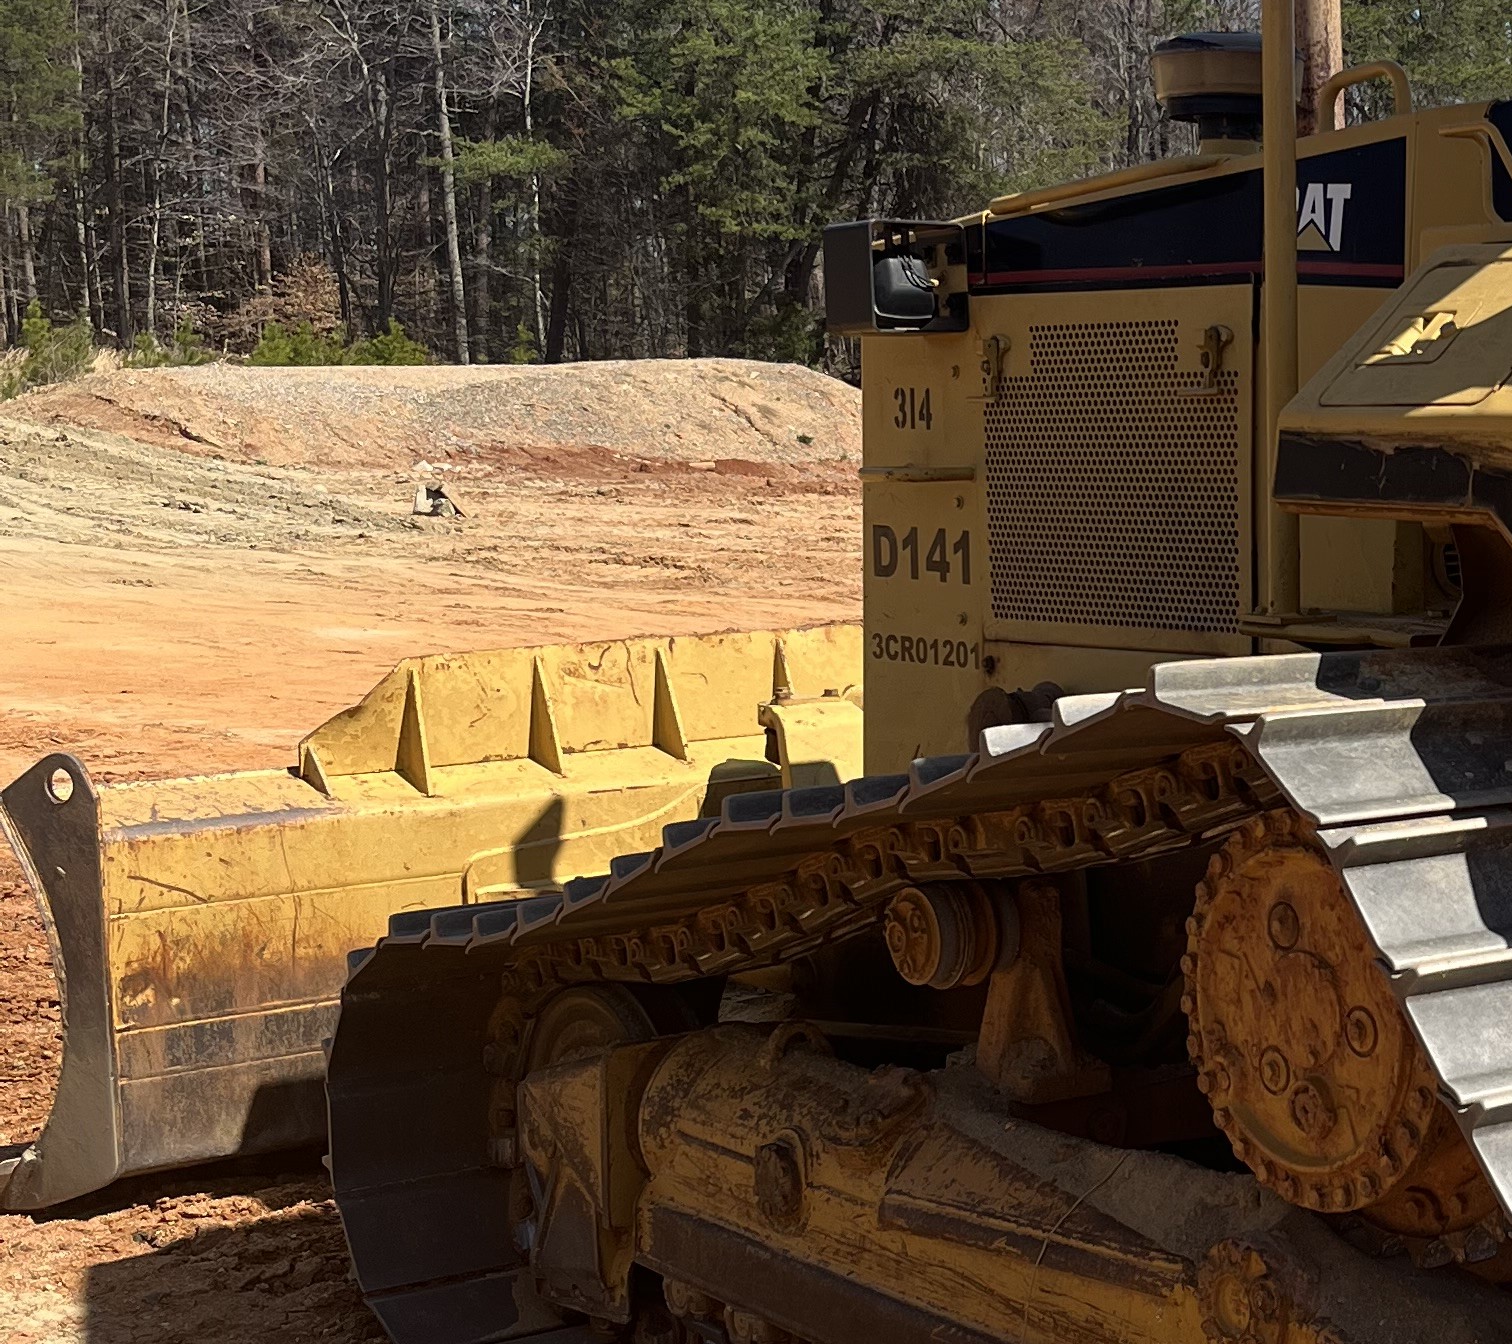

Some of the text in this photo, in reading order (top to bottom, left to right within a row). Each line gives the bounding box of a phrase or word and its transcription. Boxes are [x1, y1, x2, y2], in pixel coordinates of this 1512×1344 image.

[1296, 183, 1352, 251] AT
[894, 387, 932, 430] 314
[872, 524, 971, 585] D141
[871, 632, 980, 670] 3CR01201
